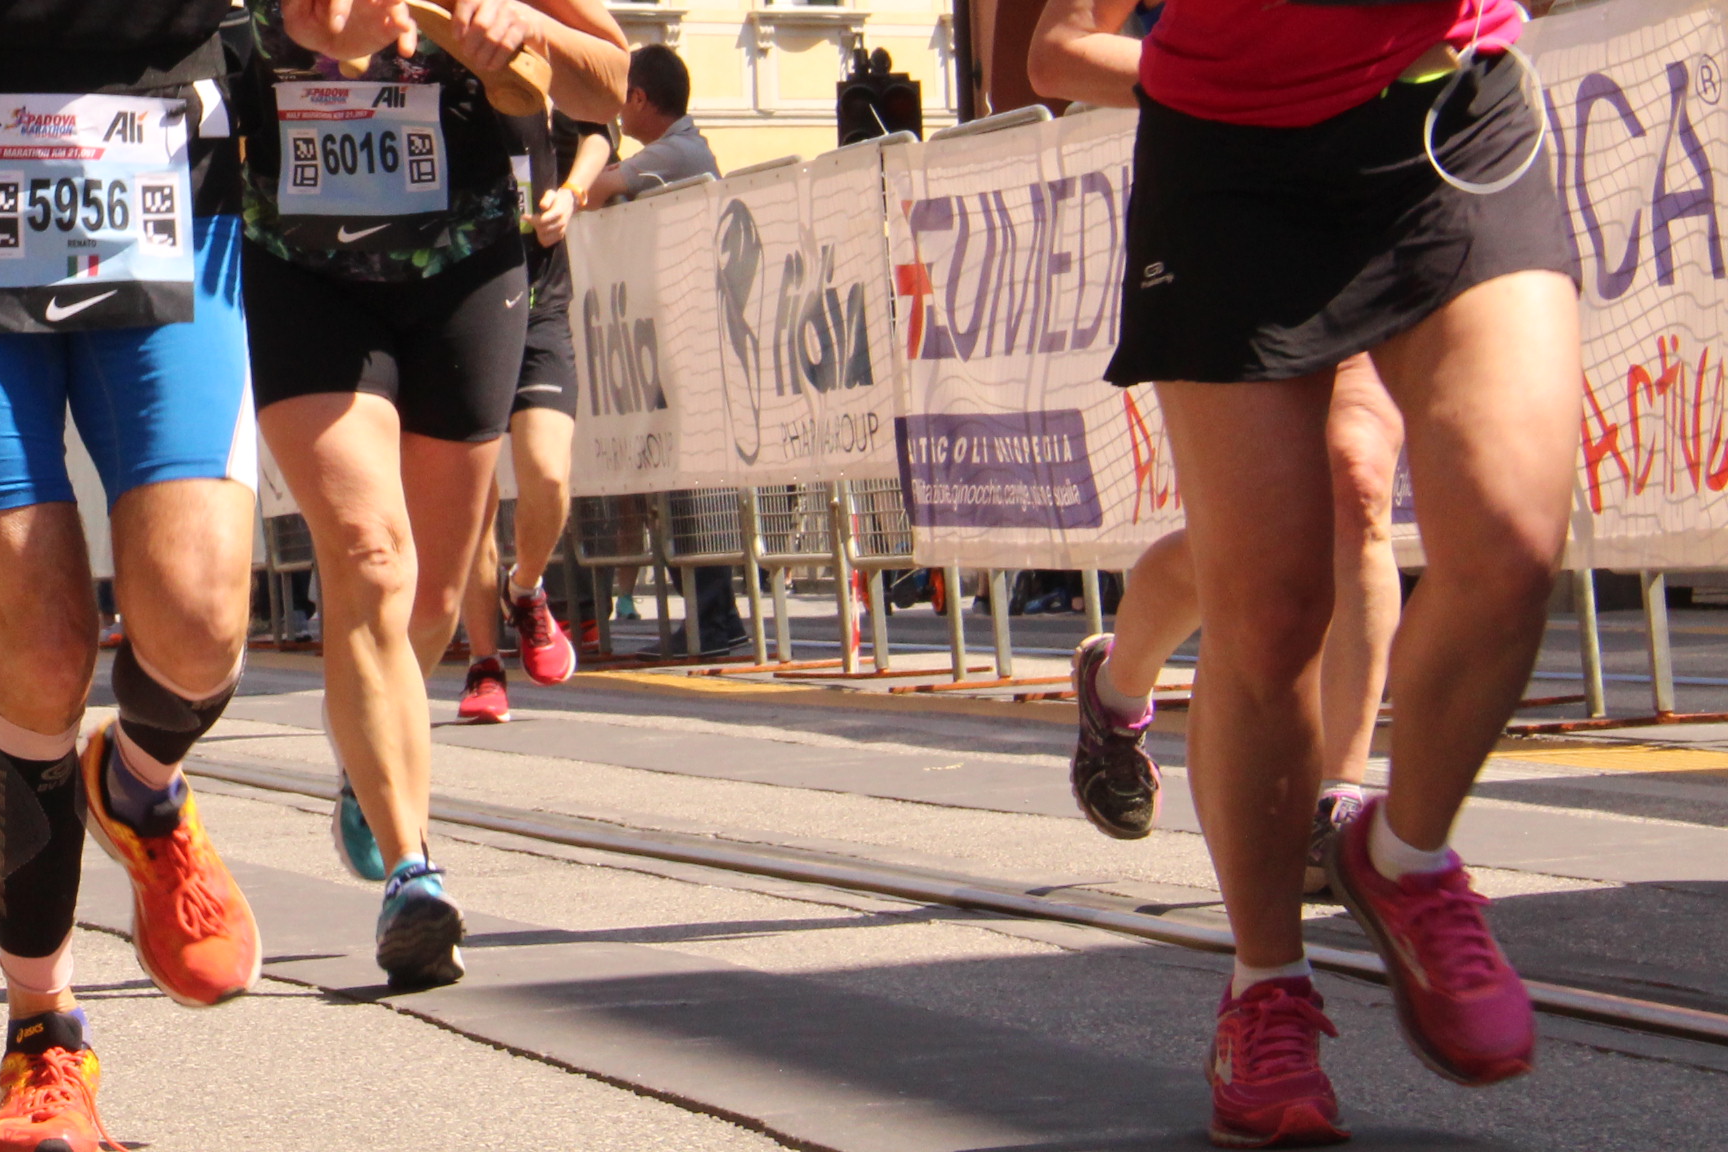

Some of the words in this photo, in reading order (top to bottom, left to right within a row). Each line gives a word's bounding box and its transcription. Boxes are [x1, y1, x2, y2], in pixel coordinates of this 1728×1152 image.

[314, 88, 350, 97] PADOVA
[372, 86, 409, 108] Ali
[26, 114, 77, 127] PADOVA
[102, 110, 148, 144] Ali
[20, 124, 73, 136] MARATHON
[3, 148, 50, 158] MARATHON
[51, 148, 66, 158] KM
[322, 131, 399, 176] 6016
[27, 177, 130, 233] 5956
[67, 239, 97, 248] RENATO
[583, 281, 668, 417] fidia
